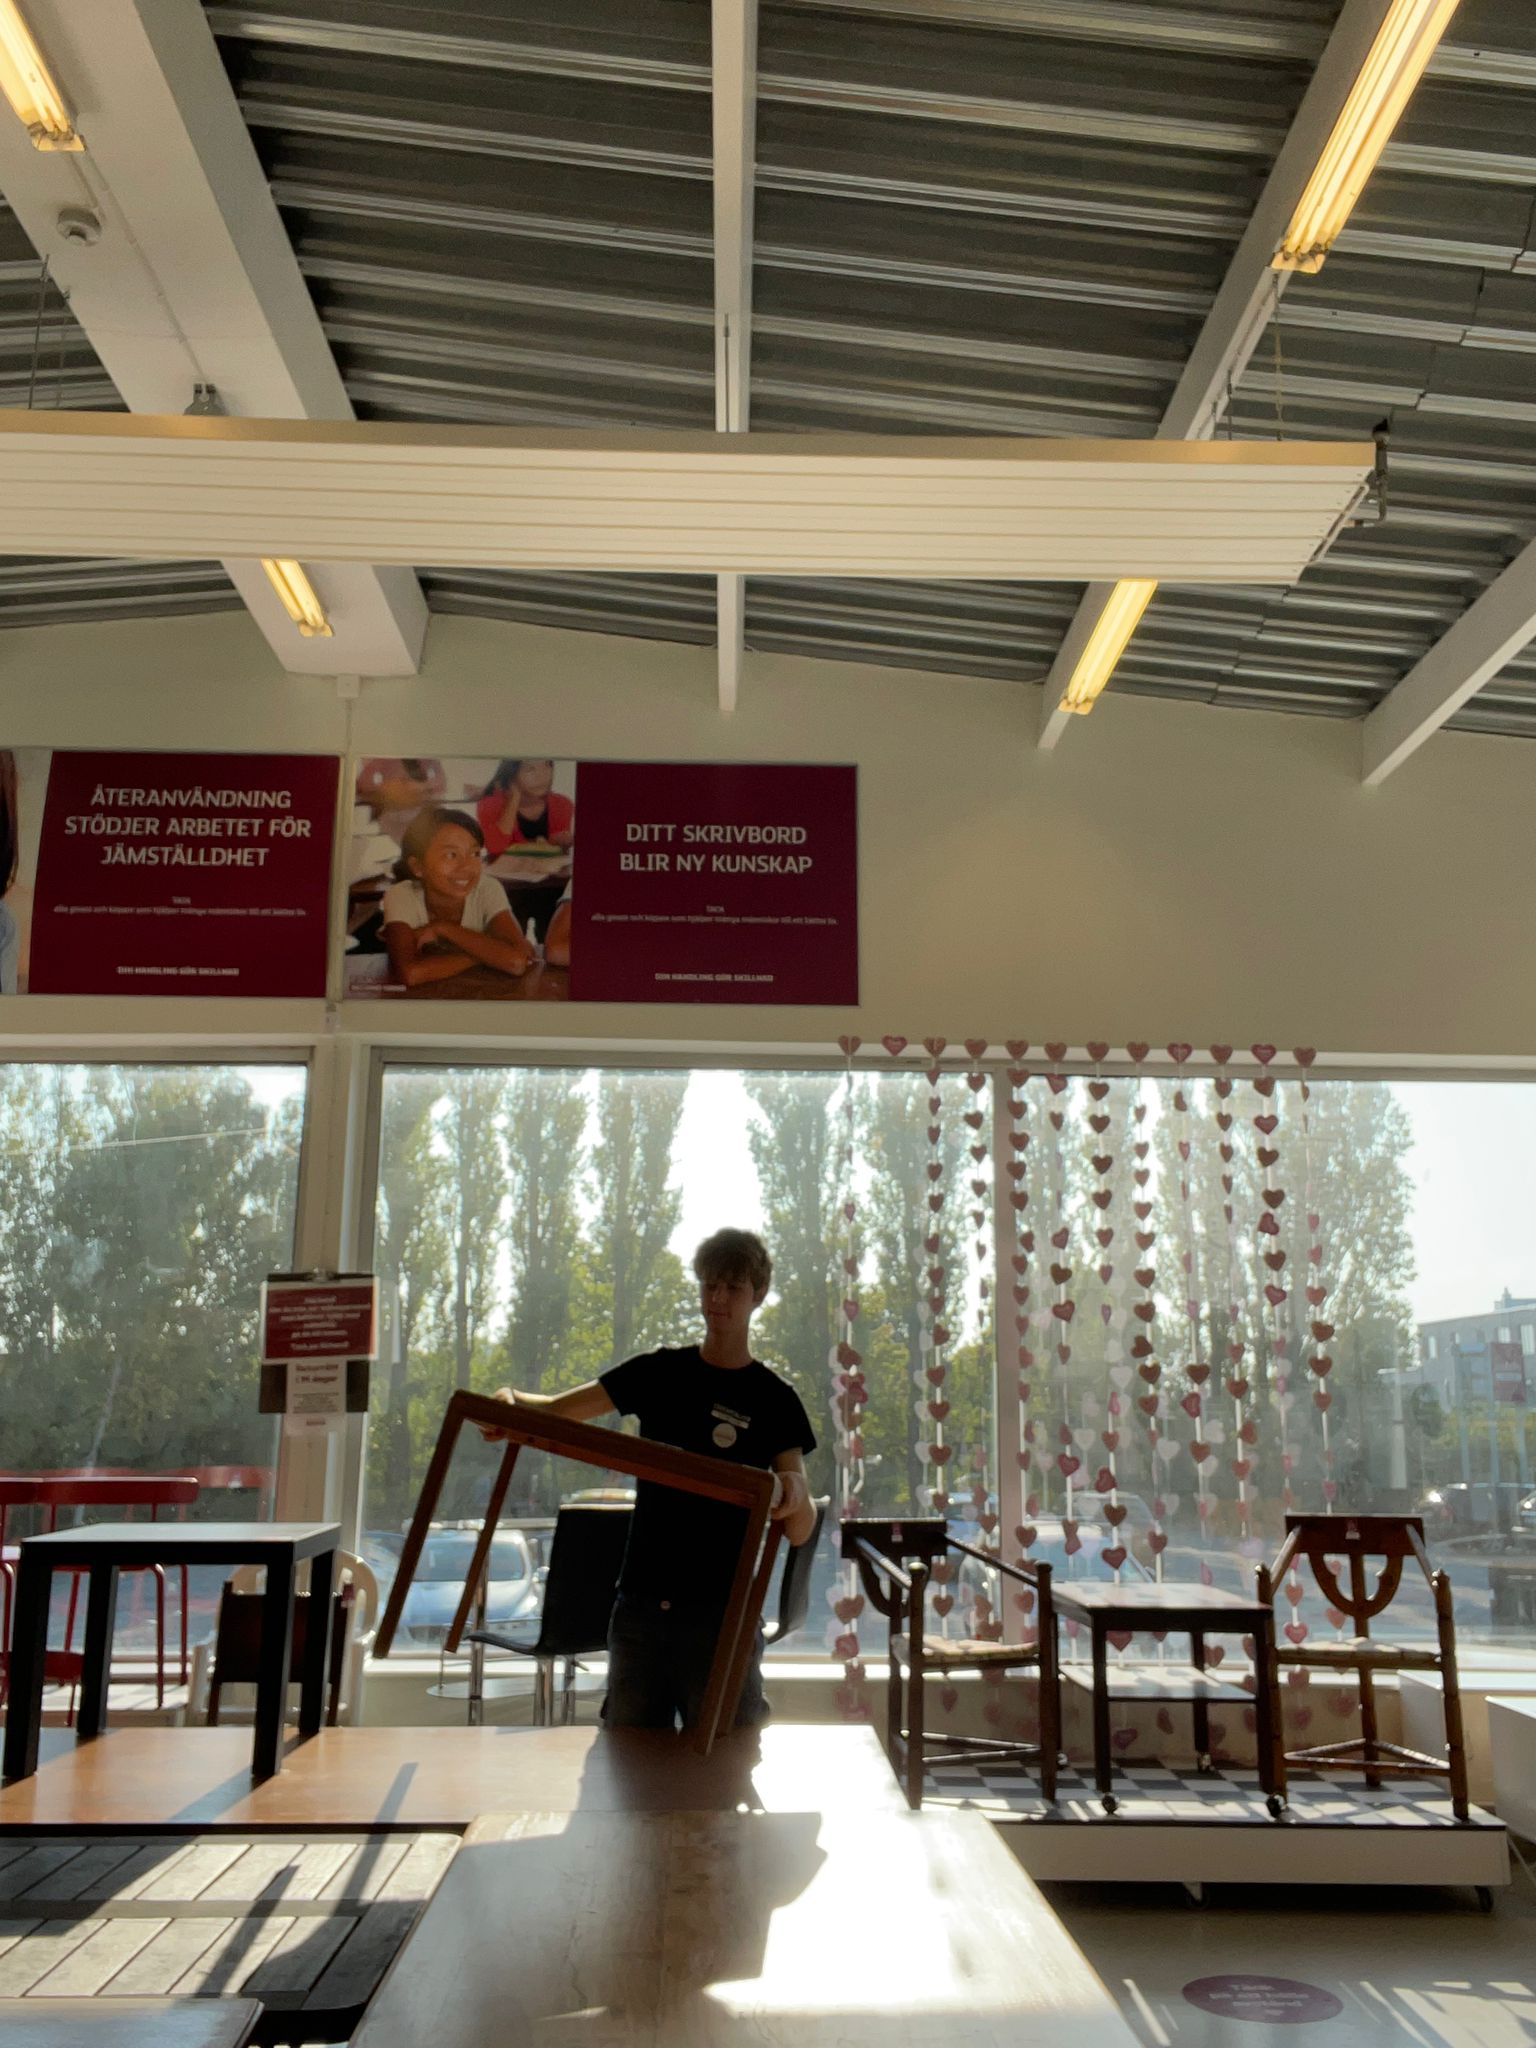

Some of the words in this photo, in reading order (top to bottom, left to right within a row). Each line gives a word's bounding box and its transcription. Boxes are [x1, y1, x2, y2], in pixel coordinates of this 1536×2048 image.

[91, 783, 292, 809] ÅTERANVÄNDNING
[65, 813, 160, 836] STÖDJER
[166, 817, 264, 837] ARBETET
[269, 815, 312, 838] FÖR
[626, 823, 677, 842] DITT
[683, 824, 807, 845] SKRIVBORD
[101, 842, 270, 867] JÄMSTÄLLDHET
[619, 852, 670, 872] BLIR
[676, 854, 706, 872] NY
[711, 854, 813, 874] KUNSKAP
